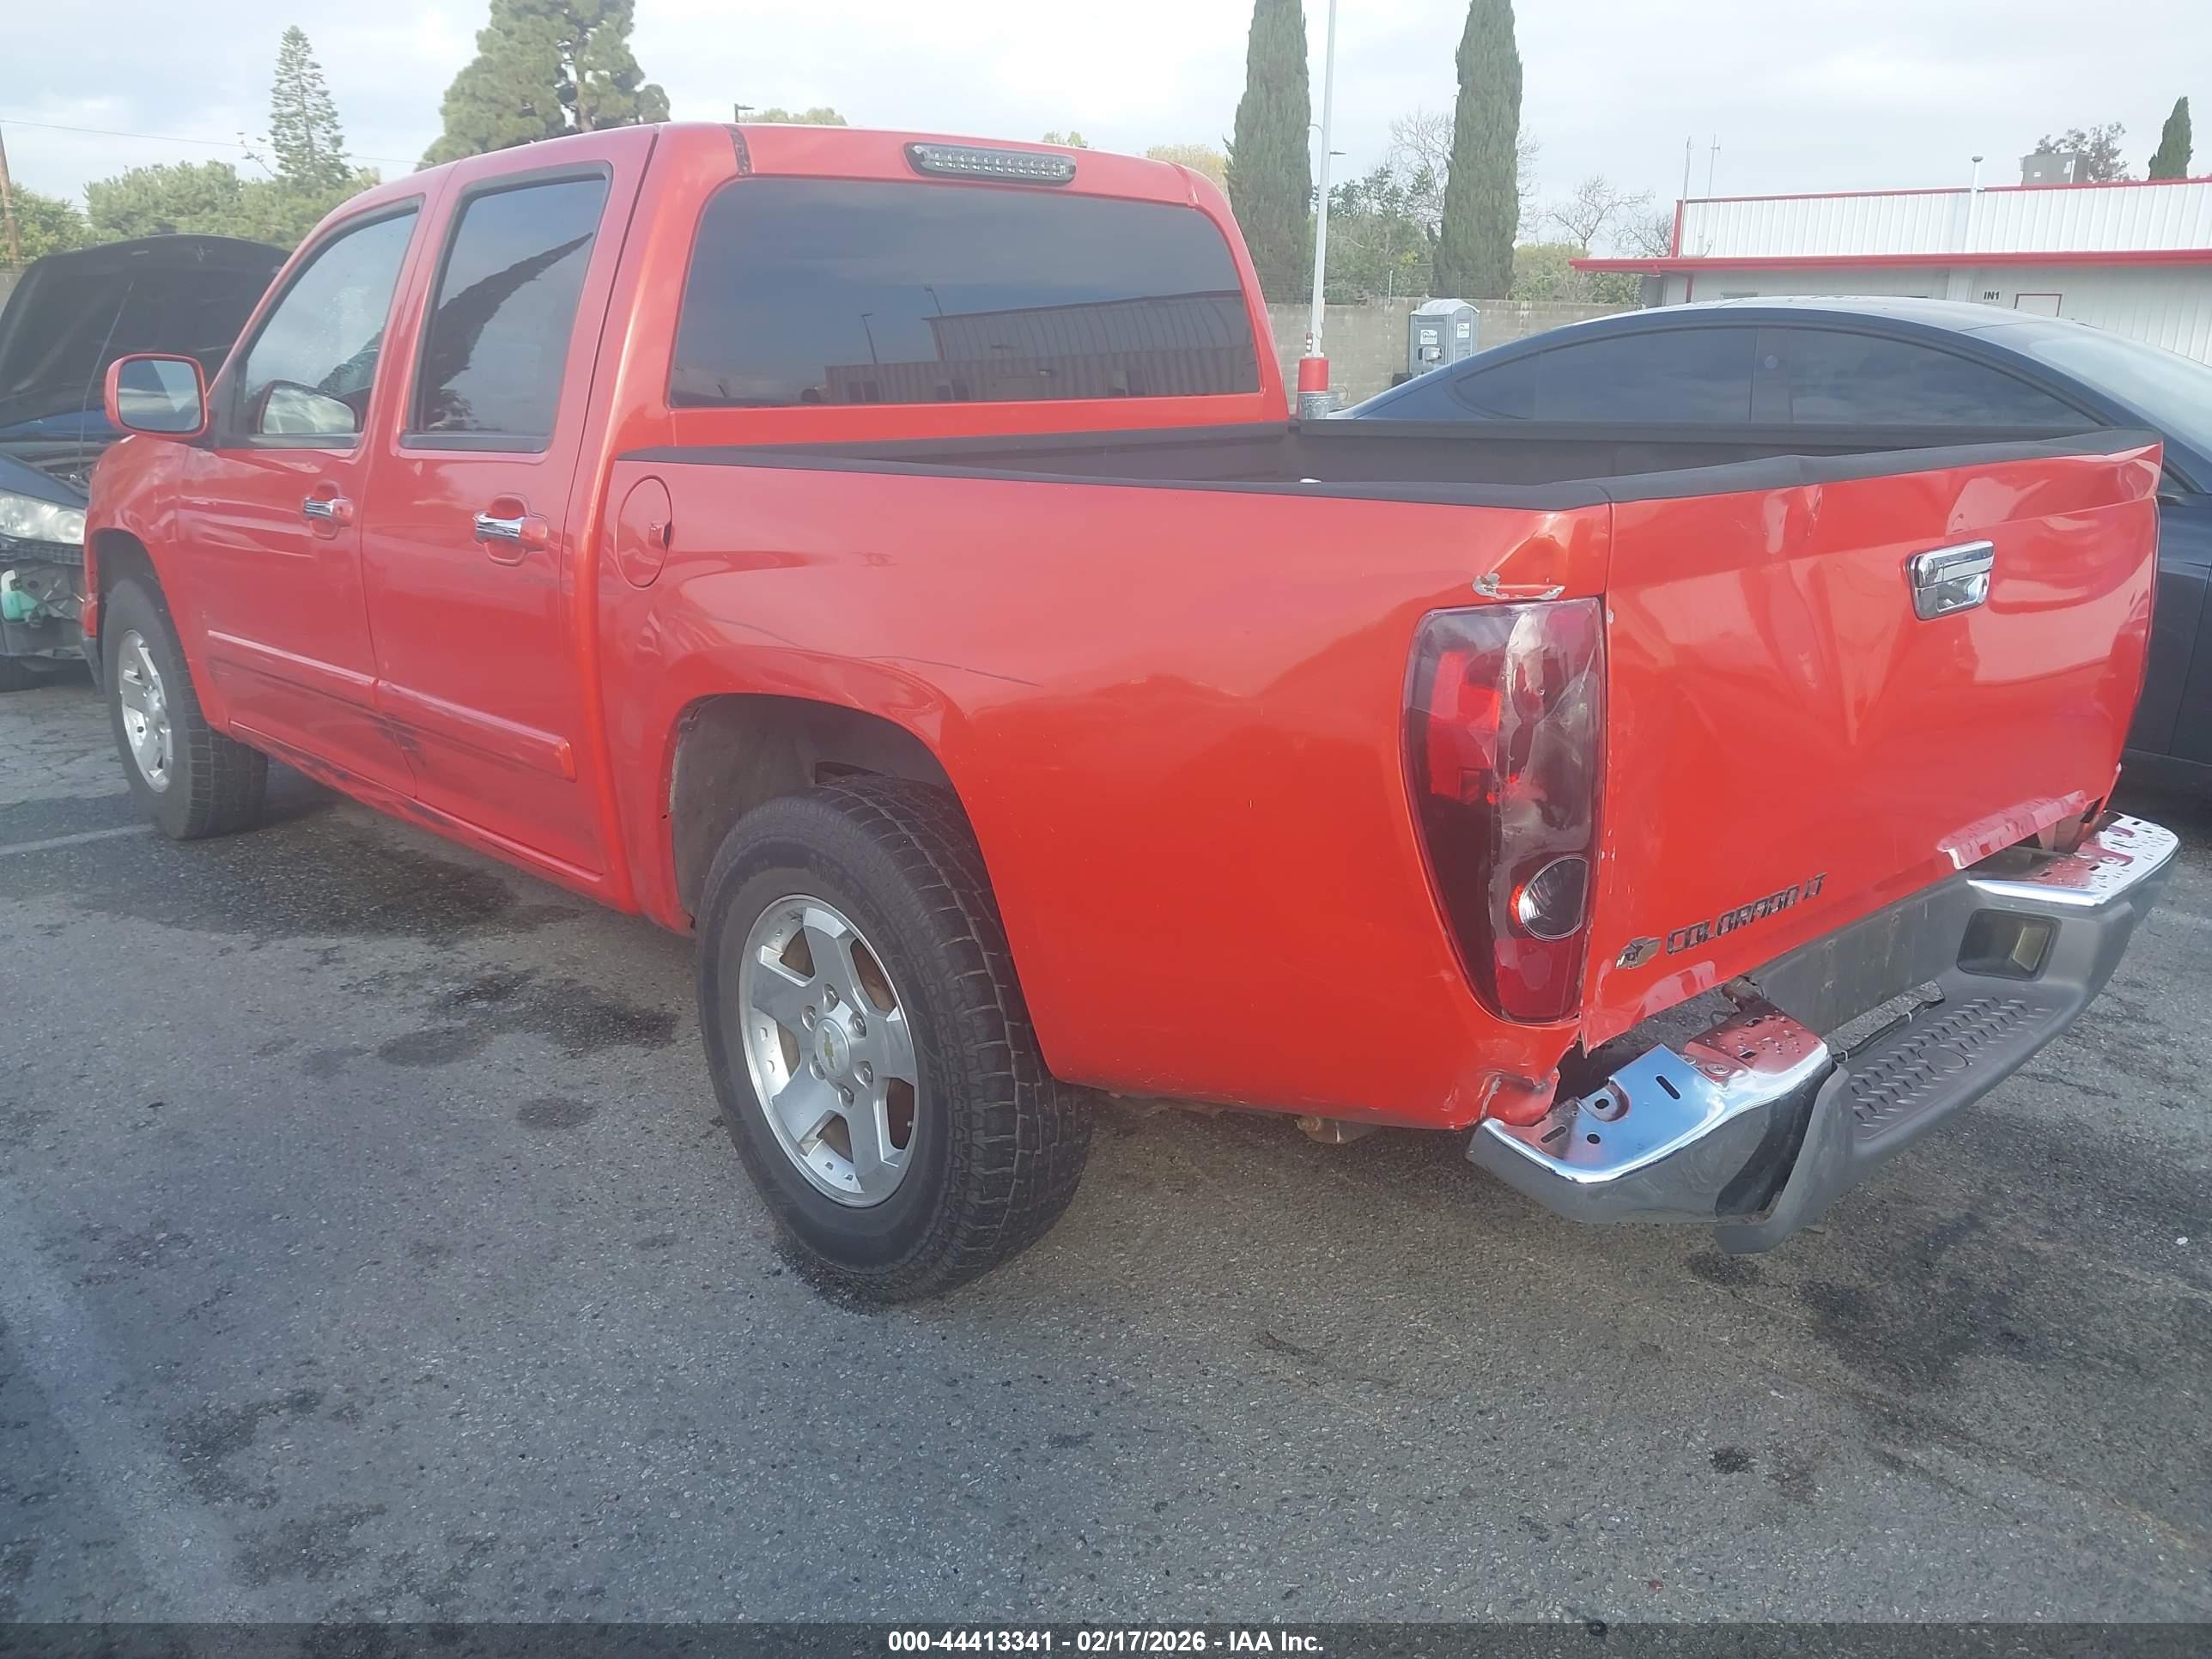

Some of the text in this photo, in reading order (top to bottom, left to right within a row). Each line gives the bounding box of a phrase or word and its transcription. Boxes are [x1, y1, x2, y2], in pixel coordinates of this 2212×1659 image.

[1983, 291, 2001, 301] IN1
[1666, 872, 1828, 955] COLORADO LT
